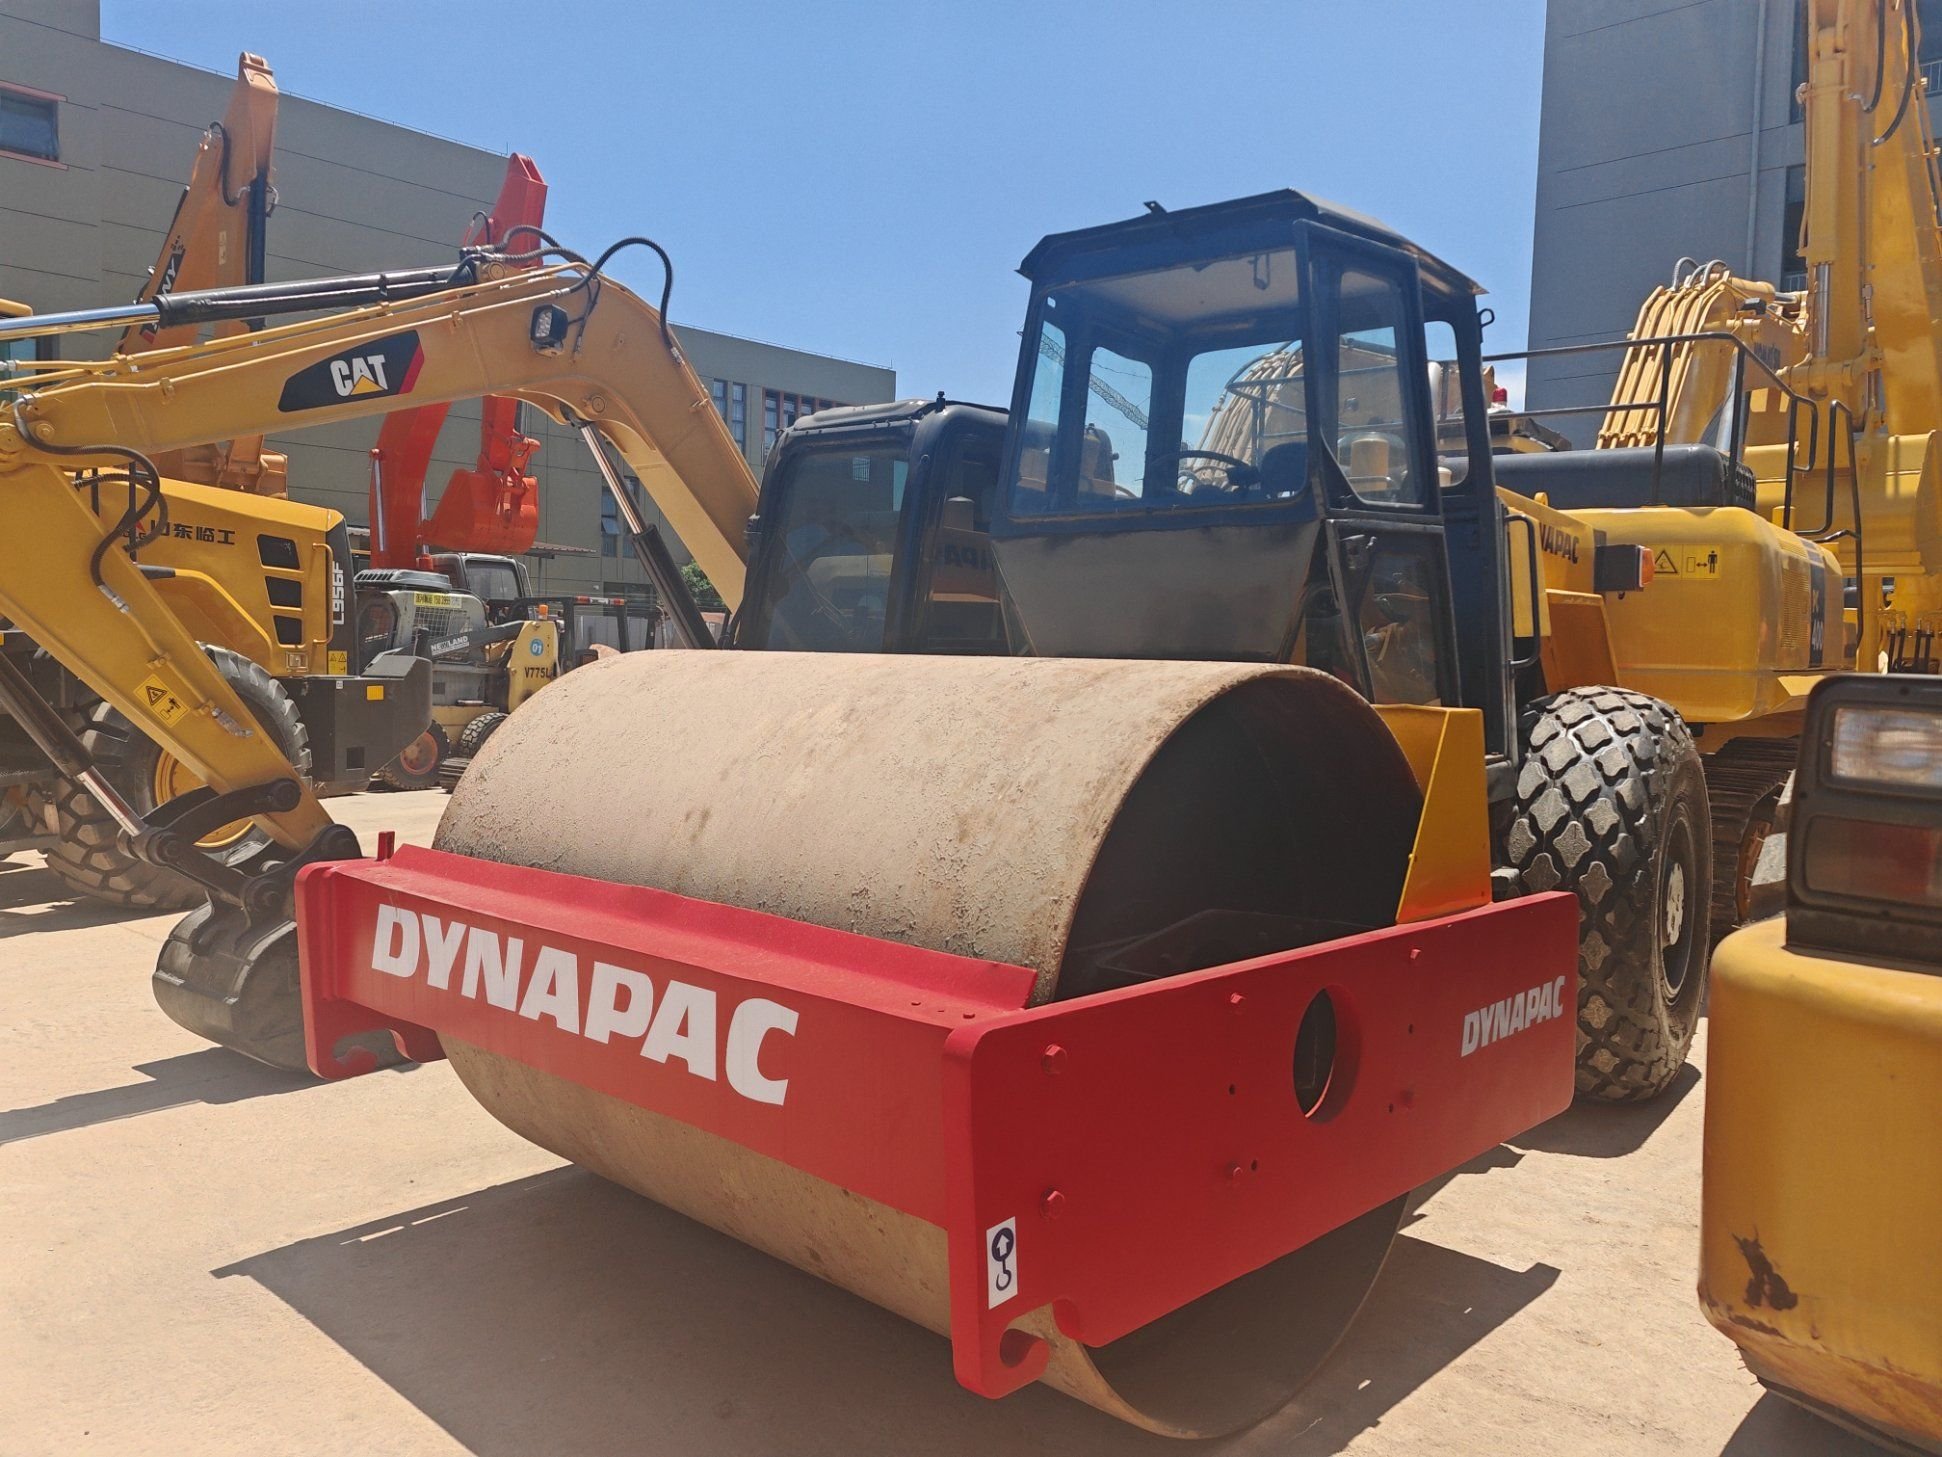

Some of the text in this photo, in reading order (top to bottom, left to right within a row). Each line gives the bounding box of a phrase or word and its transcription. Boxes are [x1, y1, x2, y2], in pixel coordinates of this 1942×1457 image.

[330, 354, 388, 397] CAT
[332, 560, 345, 625] L956F
[371, 903, 800, 1106] DYNAPAC
[1460, 975, 1566, 1058] DYNAPAC
